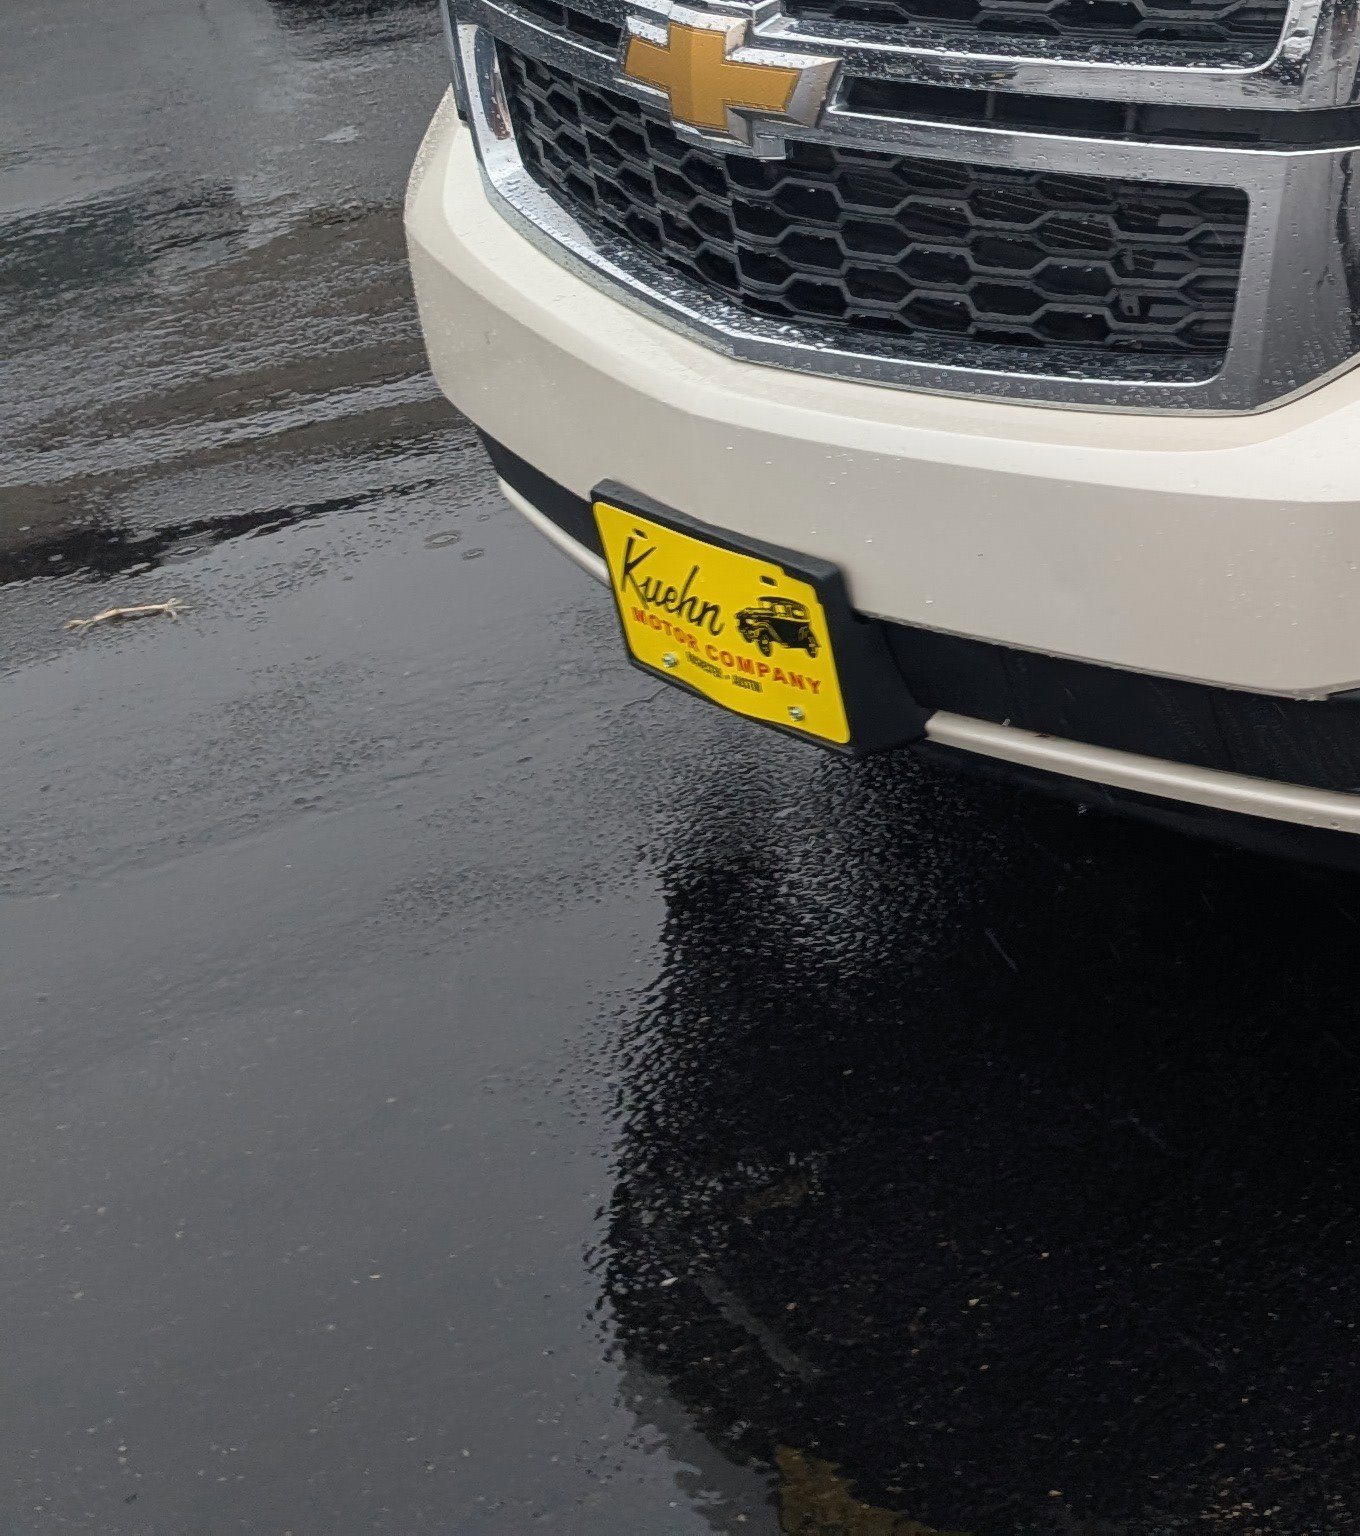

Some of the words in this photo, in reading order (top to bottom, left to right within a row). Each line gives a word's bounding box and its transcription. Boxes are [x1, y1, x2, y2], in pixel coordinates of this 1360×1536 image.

[620, 535, 725, 637] Kuehn
[630, 606, 700, 653] MOTOR
[704, 643, 822, 695] COMPANY
